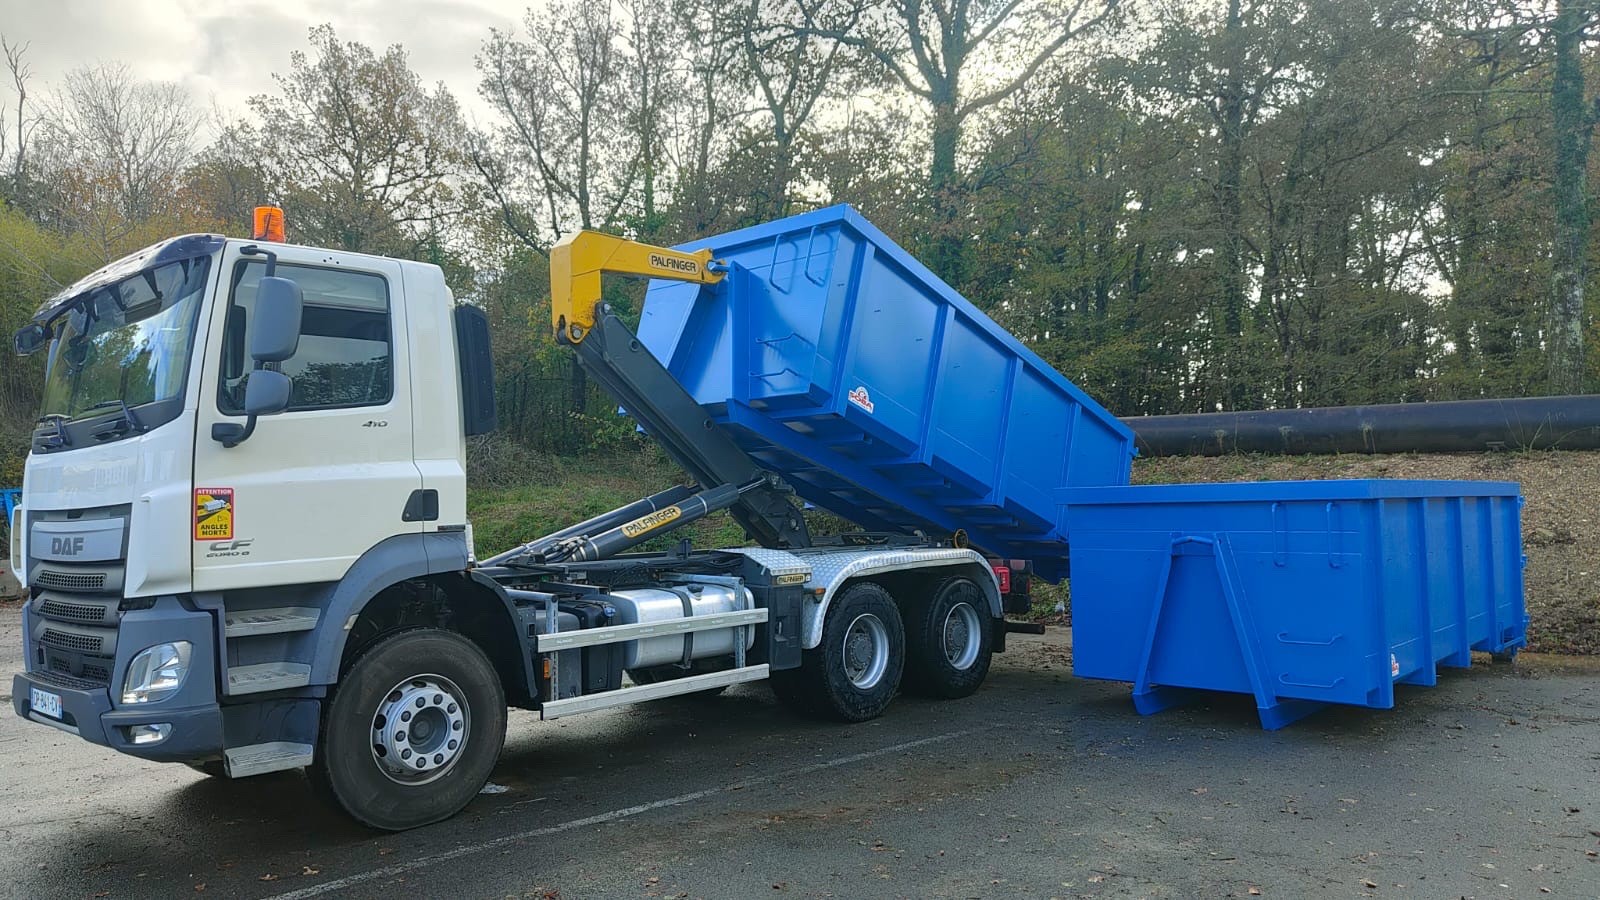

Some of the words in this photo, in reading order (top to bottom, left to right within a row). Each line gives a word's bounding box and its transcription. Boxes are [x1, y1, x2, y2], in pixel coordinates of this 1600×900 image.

[651, 255, 696, 272] PALFINGER
[361, 420, 388, 428] 410
[626, 507, 677, 536] PALFINGER
[51, 537, 84, 556] DAF
[209, 538, 255, 551] CF
